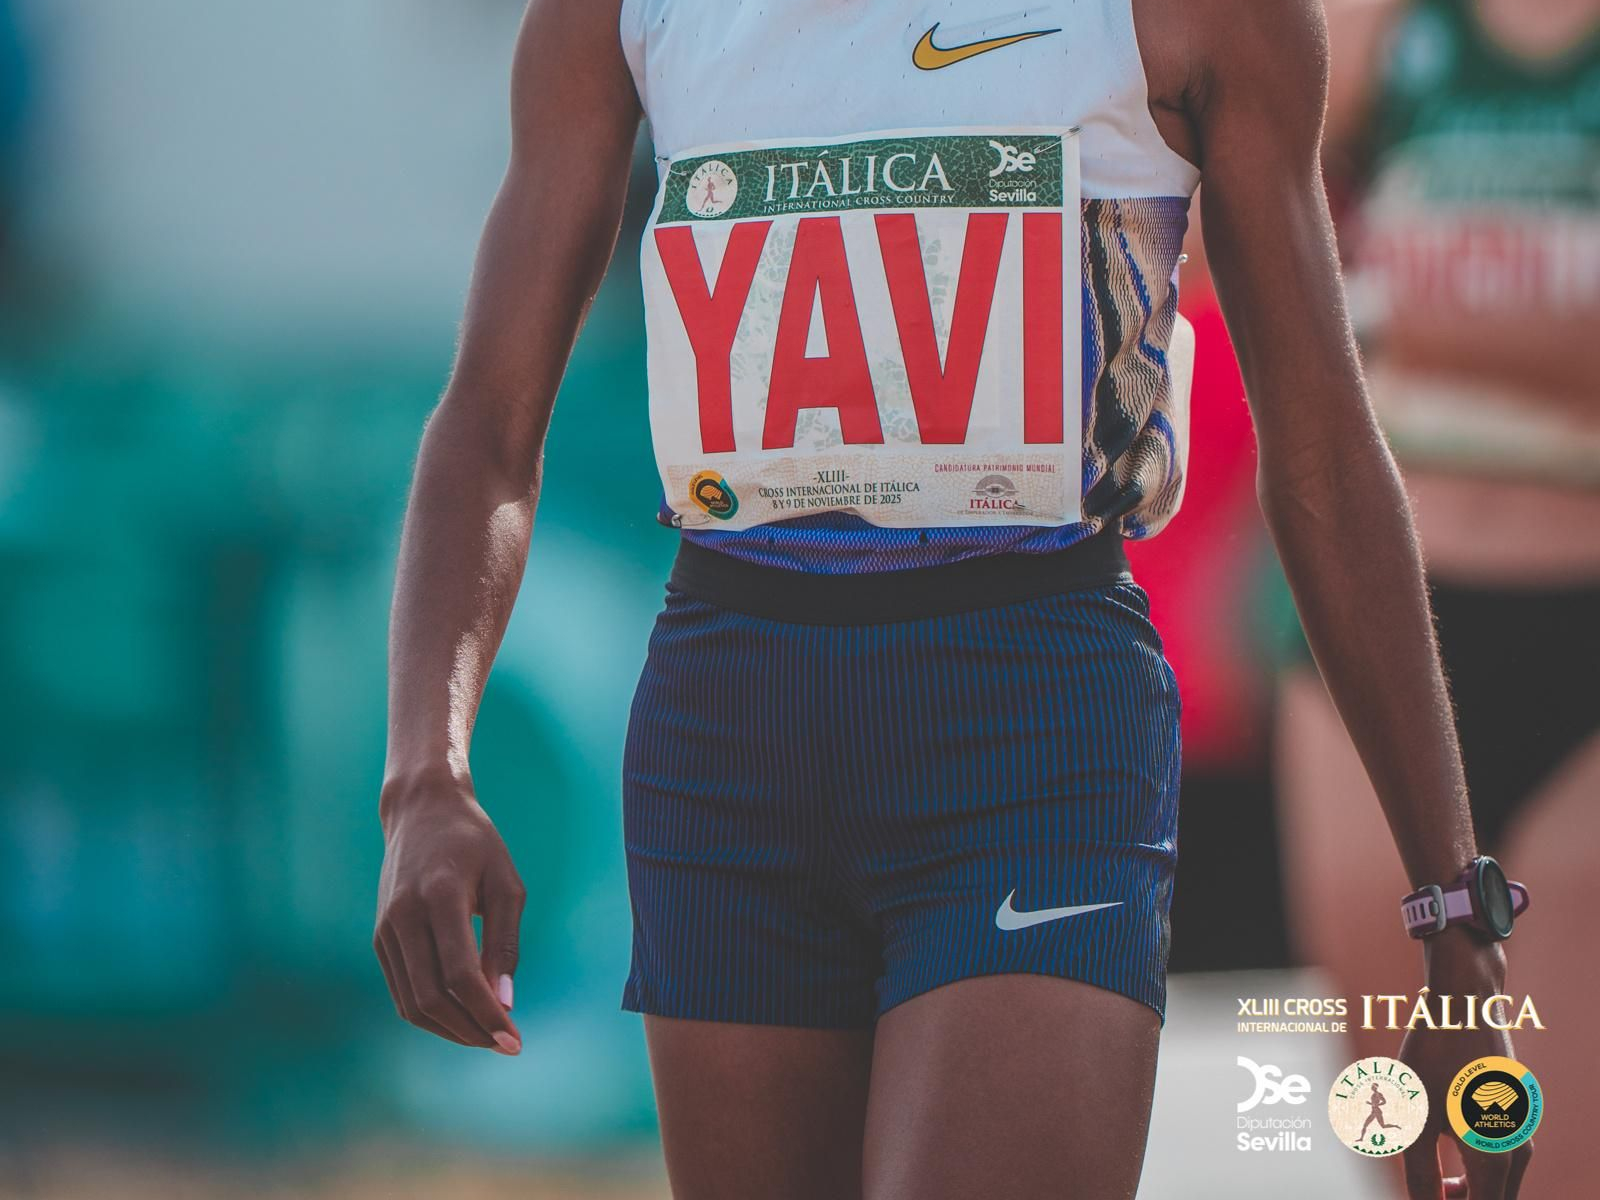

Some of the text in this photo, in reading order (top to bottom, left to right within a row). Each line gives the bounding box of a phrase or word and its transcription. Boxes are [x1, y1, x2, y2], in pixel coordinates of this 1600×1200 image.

[763, 150, 955, 202] ITÁLICA
[989, 178, 1036, 189] Diputación
[989, 189, 1036, 202] Sevilla
[763, 194, 955, 214] INTERNATIONAL CROSS COUNTRY
[654, 212, 1065, 454] YAVI
[934, 463, 1056, 473] CANDIDATURA PATRIMONIO MUNDIAL
[758, 480, 920, 498] CROSS INTERNACIONAL DE ITÁLICA
[772, 494, 902, 509] 8 Y 9 DE NOVIEMBRE DE 2025
